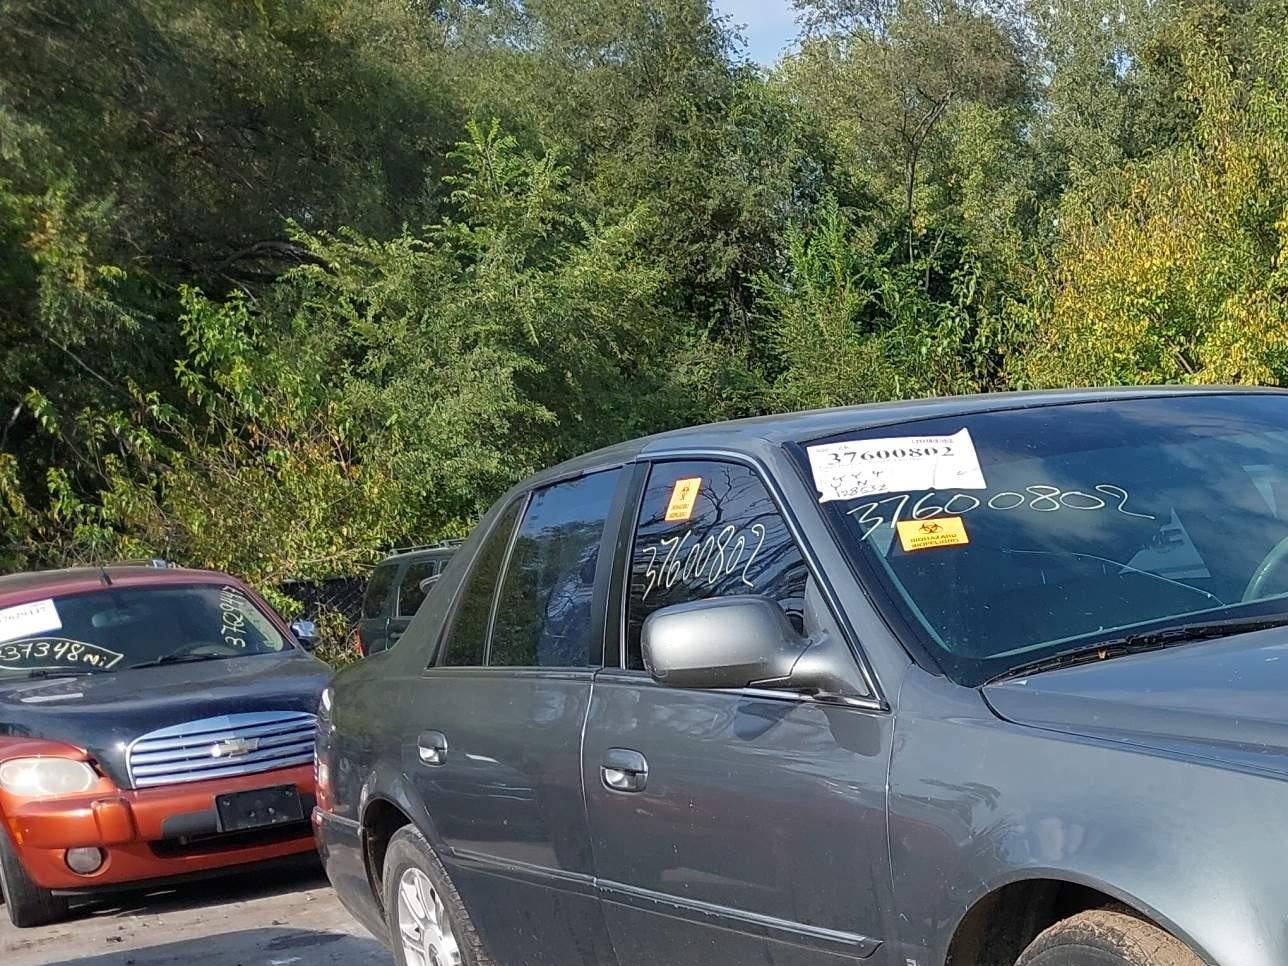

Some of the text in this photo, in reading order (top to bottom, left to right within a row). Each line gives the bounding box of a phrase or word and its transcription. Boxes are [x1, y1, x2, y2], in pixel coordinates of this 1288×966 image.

[827, 446, 955, 465] 37600802
[846, 484, 1156, 541] 37600802
[642, 523, 766, 601] 37600802
